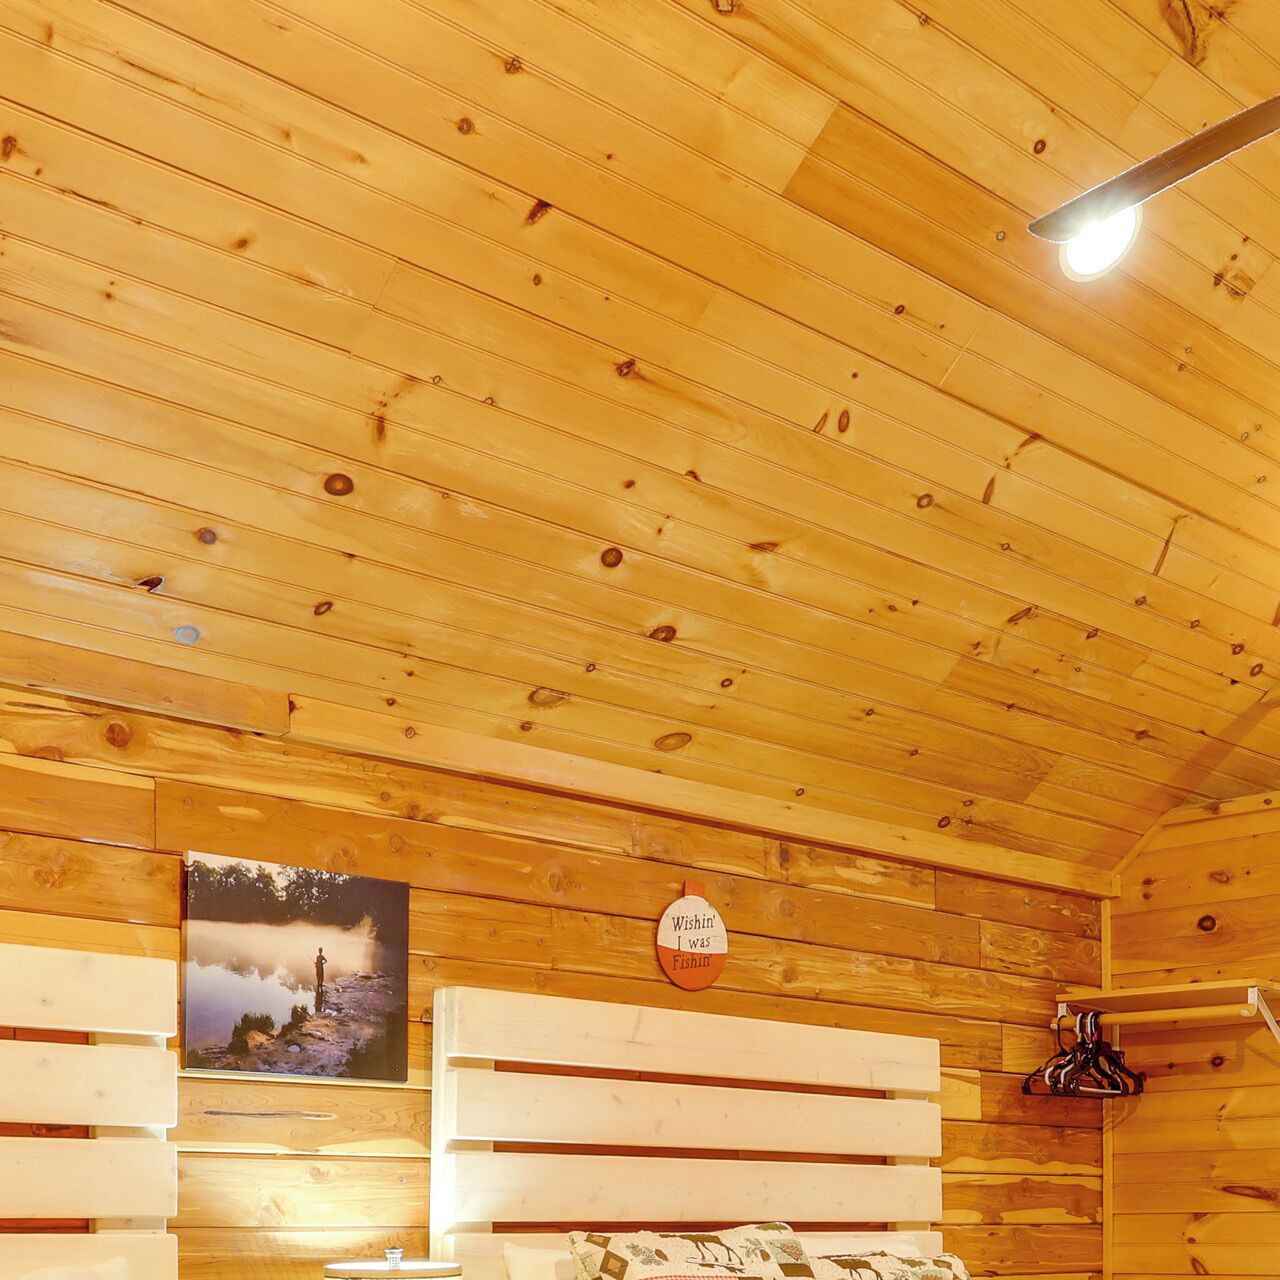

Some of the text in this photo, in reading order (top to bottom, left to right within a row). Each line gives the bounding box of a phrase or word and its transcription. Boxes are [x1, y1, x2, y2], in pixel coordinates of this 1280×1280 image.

[672, 914, 716, 932] Wishin'
[677, 936, 711, 950] I was
[672, 952, 713, 970] Fishin'
